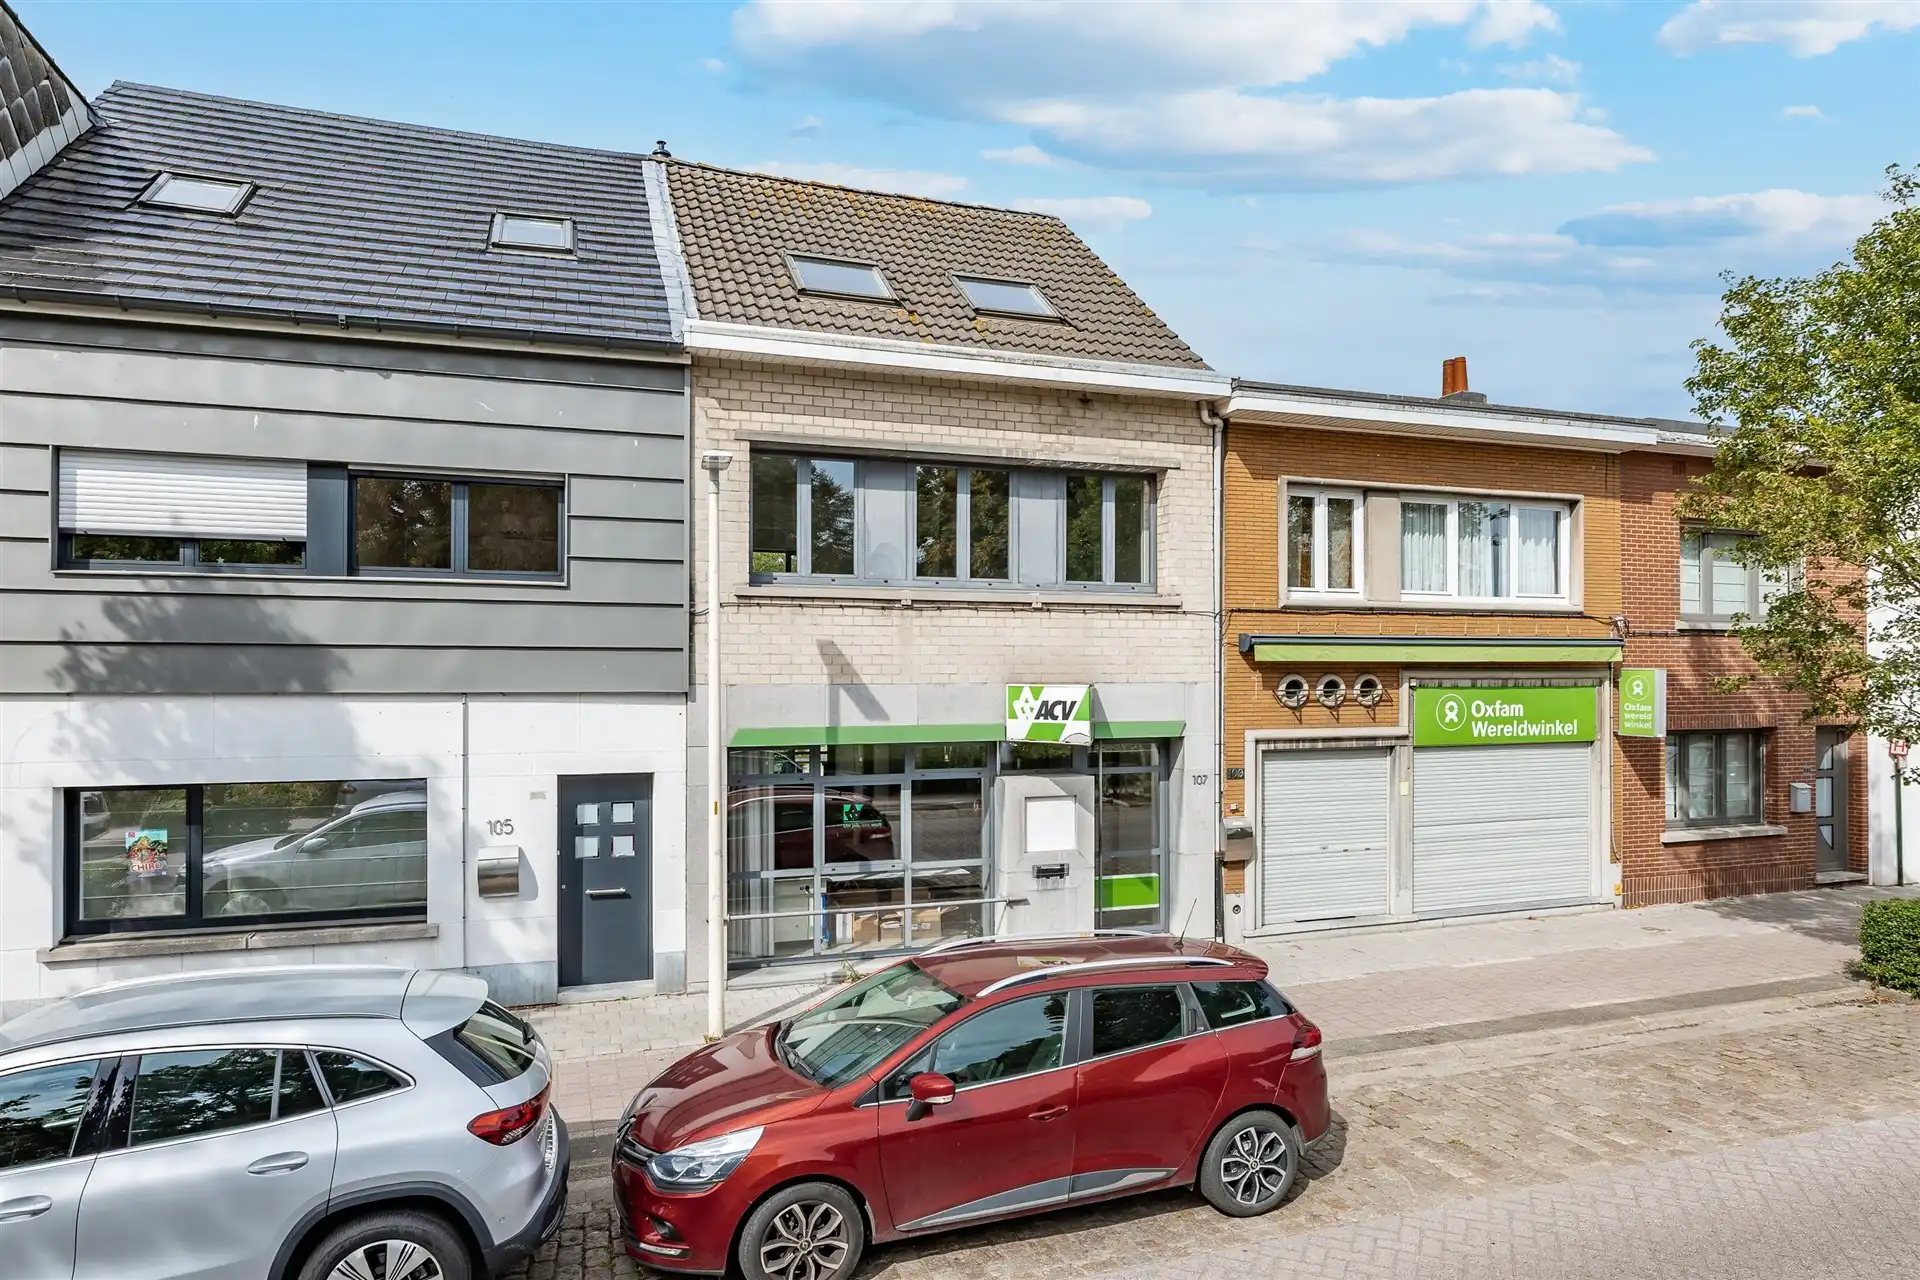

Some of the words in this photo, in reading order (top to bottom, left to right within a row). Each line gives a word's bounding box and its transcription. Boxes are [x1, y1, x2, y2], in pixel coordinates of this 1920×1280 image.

[1034, 700, 1077, 721] ACV
[1471, 700, 1524, 717] Oxfam
[1624, 703, 1652, 711] Oxfam
[1624, 712, 1652, 720] wereld
[1471, 719, 1578, 737] Wereldwinkel
[1624, 721, 1652, 729] winkel
[1893, 740, 1905, 753] H
[1192, 775, 1209, 786] 107
[487, 819, 514, 836] 105
[131, 862, 163, 872] CHIRO
